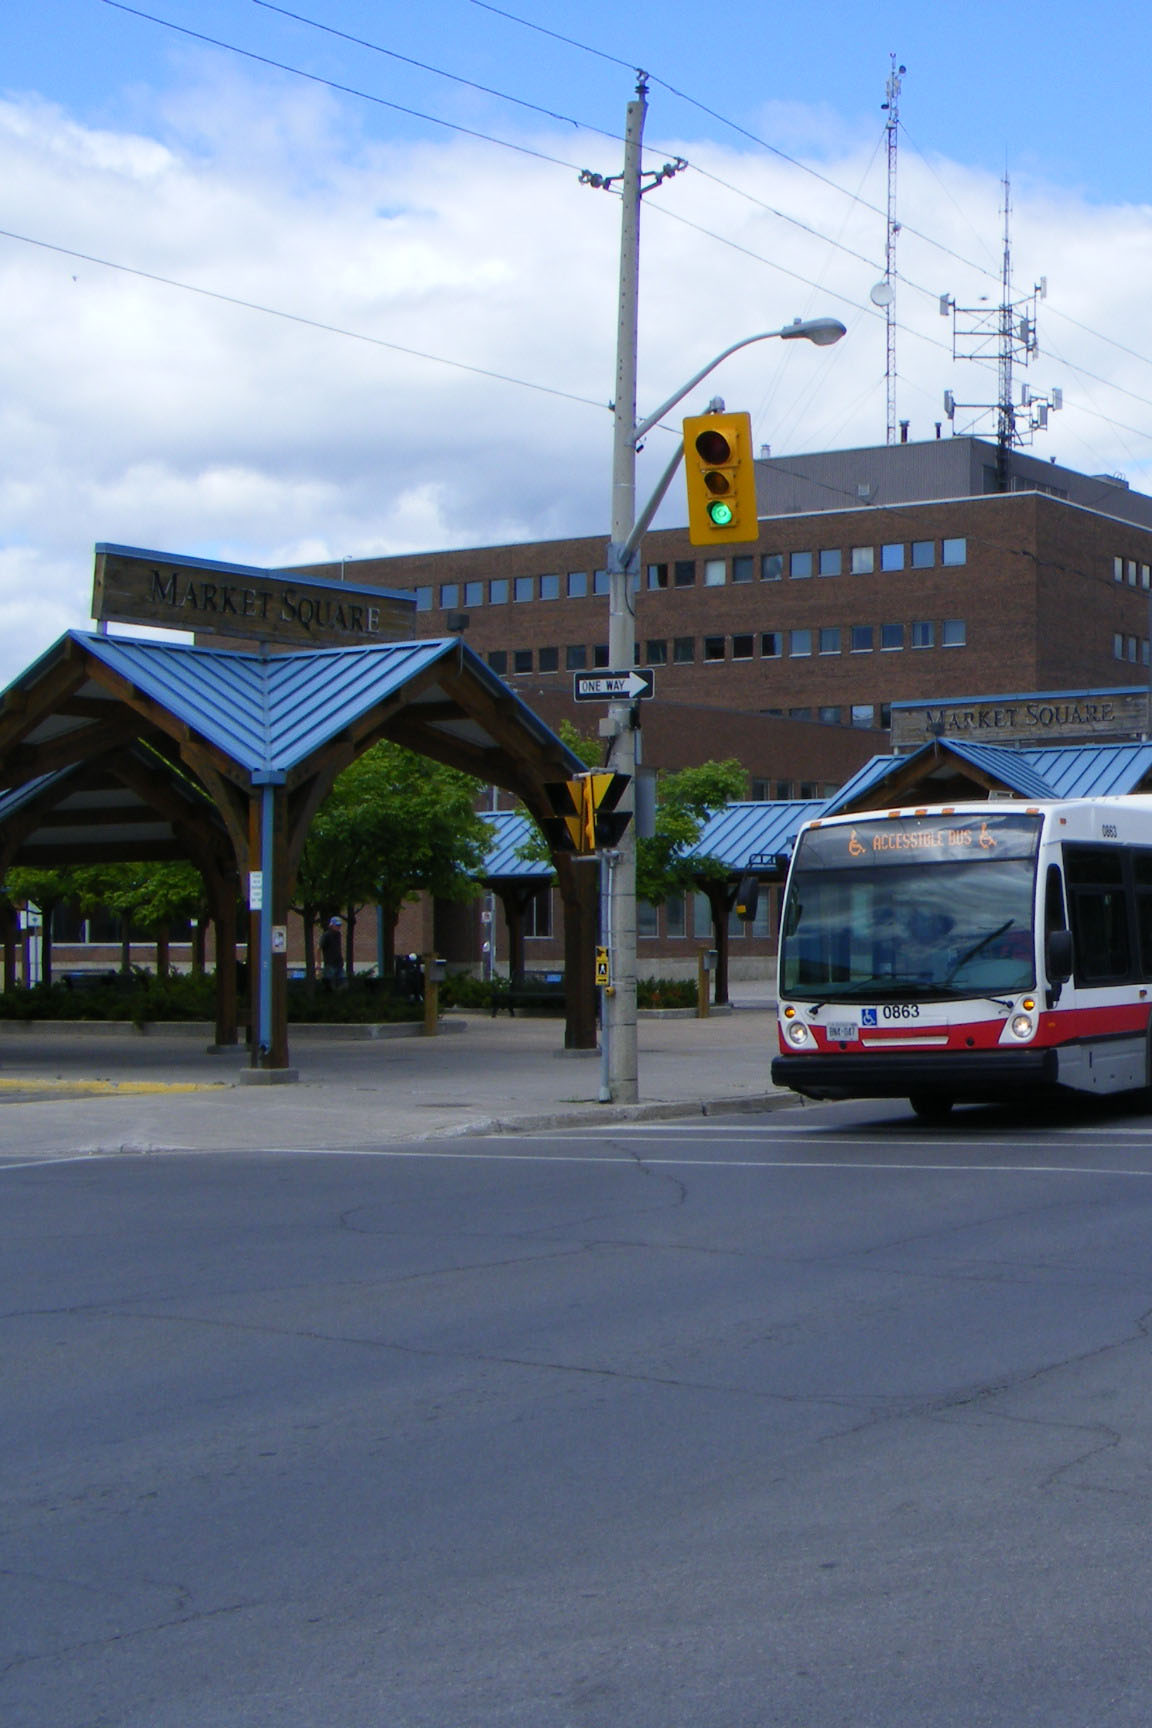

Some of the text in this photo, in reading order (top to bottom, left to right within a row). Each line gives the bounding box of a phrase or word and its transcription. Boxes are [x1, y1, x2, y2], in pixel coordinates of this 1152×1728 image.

[150, 569, 381, 633] MARKET SQUARE
[582, 679, 625, 692] ONE WAY
[926, 702, 1115, 731] MARKET SQUARE
[872, 829, 972, 850] ACCESSIBLE BUS
[1102, 824, 1117, 838] 0863
[883, 1004, 920, 1019] 0863
